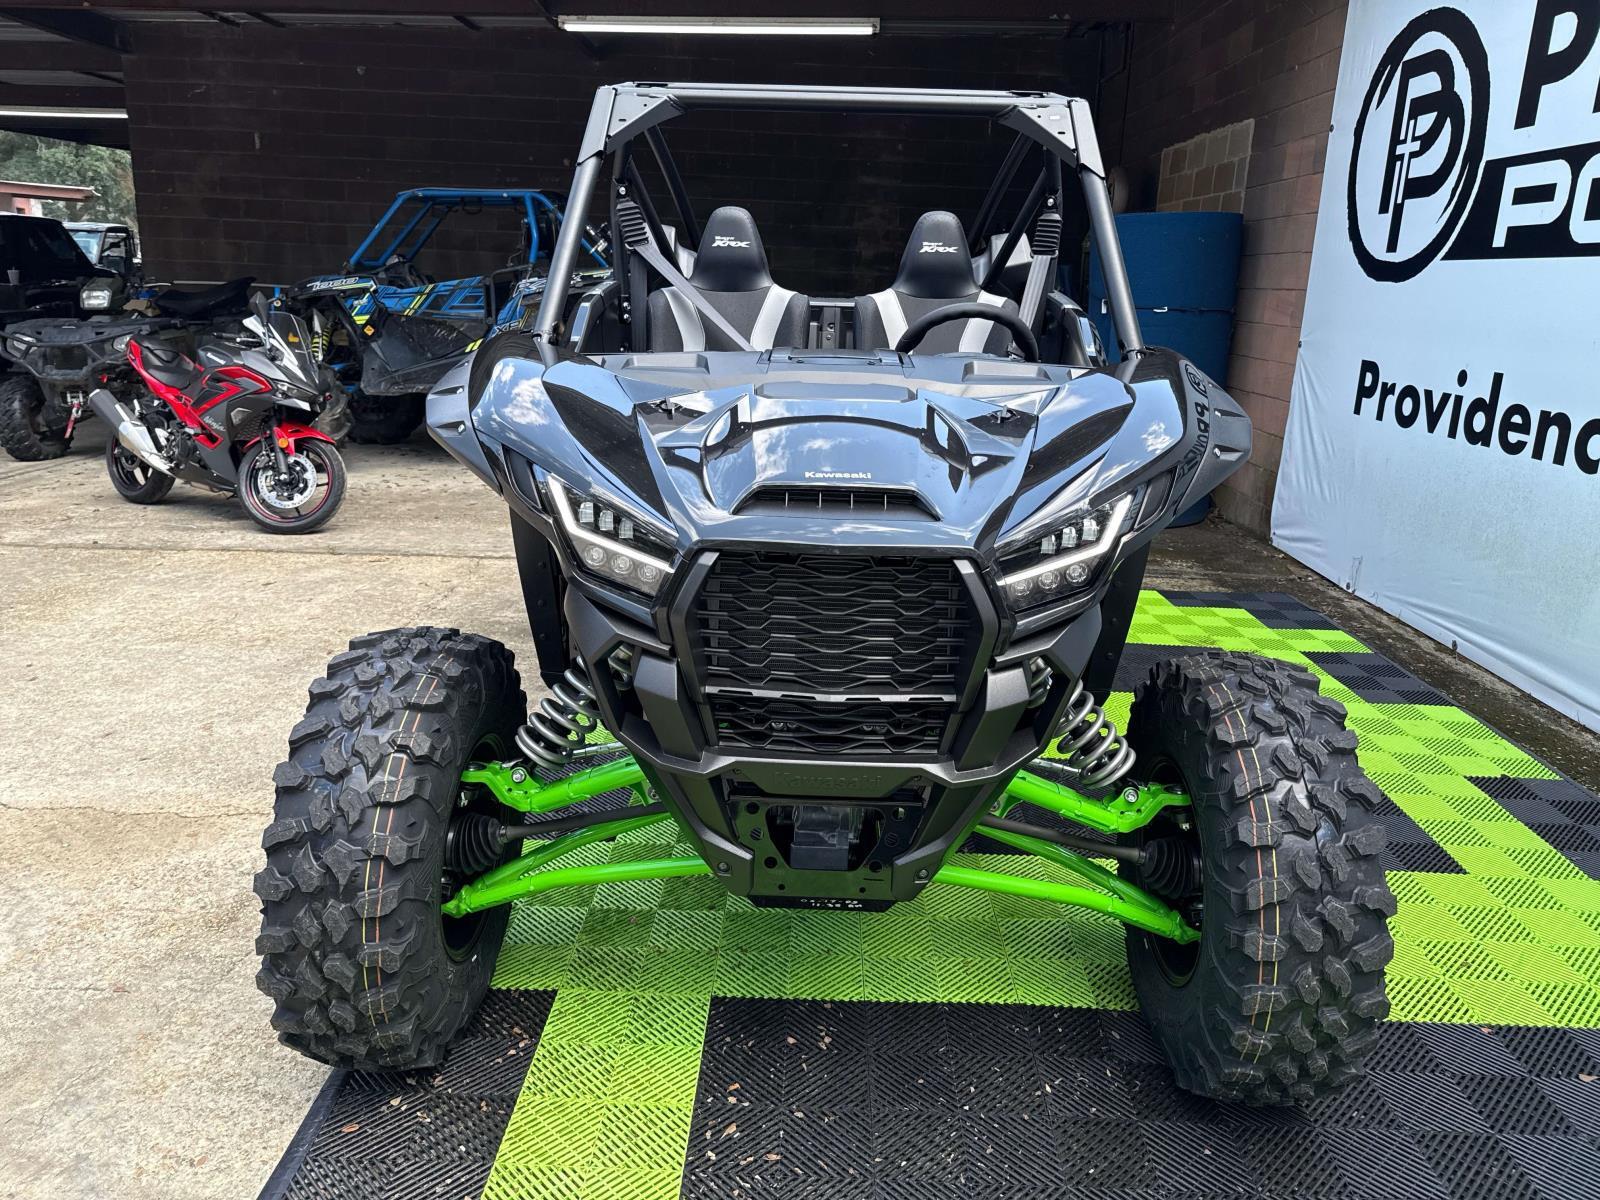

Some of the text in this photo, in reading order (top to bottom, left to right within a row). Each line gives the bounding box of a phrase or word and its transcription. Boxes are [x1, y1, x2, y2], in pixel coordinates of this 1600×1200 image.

[1513, 0, 1600, 130] P
[711, 240, 751, 248] KRX
[919, 245, 959, 253] KRX
[804, 471, 872, 479] Kawasaki
